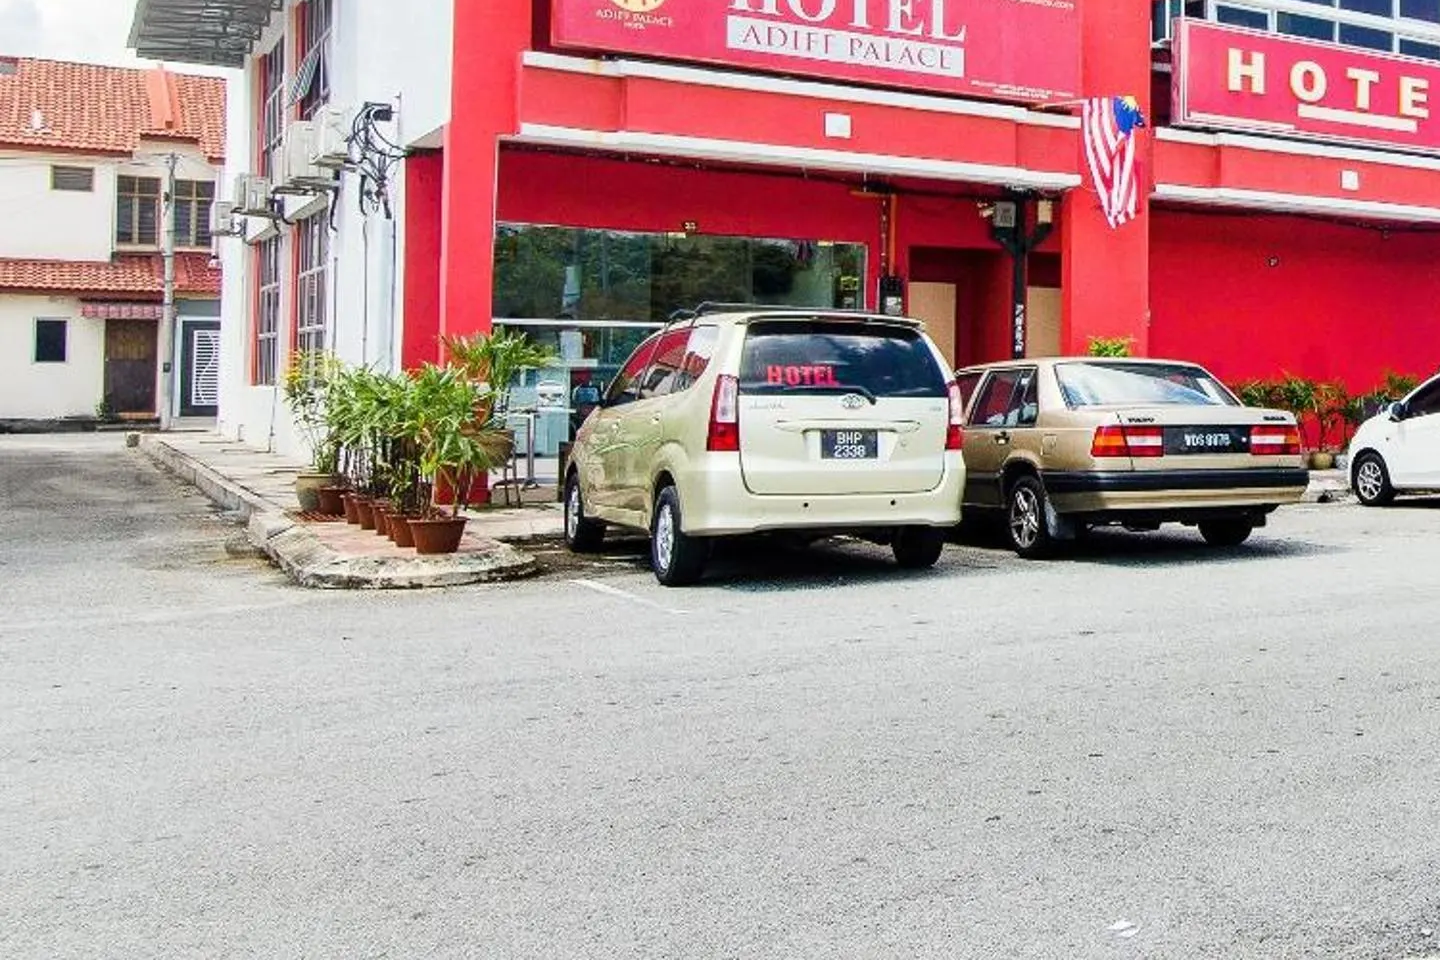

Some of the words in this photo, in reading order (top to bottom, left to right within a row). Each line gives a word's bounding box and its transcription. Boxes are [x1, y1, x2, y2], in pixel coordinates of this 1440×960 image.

[742, 24, 837, 55] ADIFF
[849, 37, 954, 71] PALACE
[766, 364, 840, 387] HOTEL
[836, 431, 864, 445] BHP
